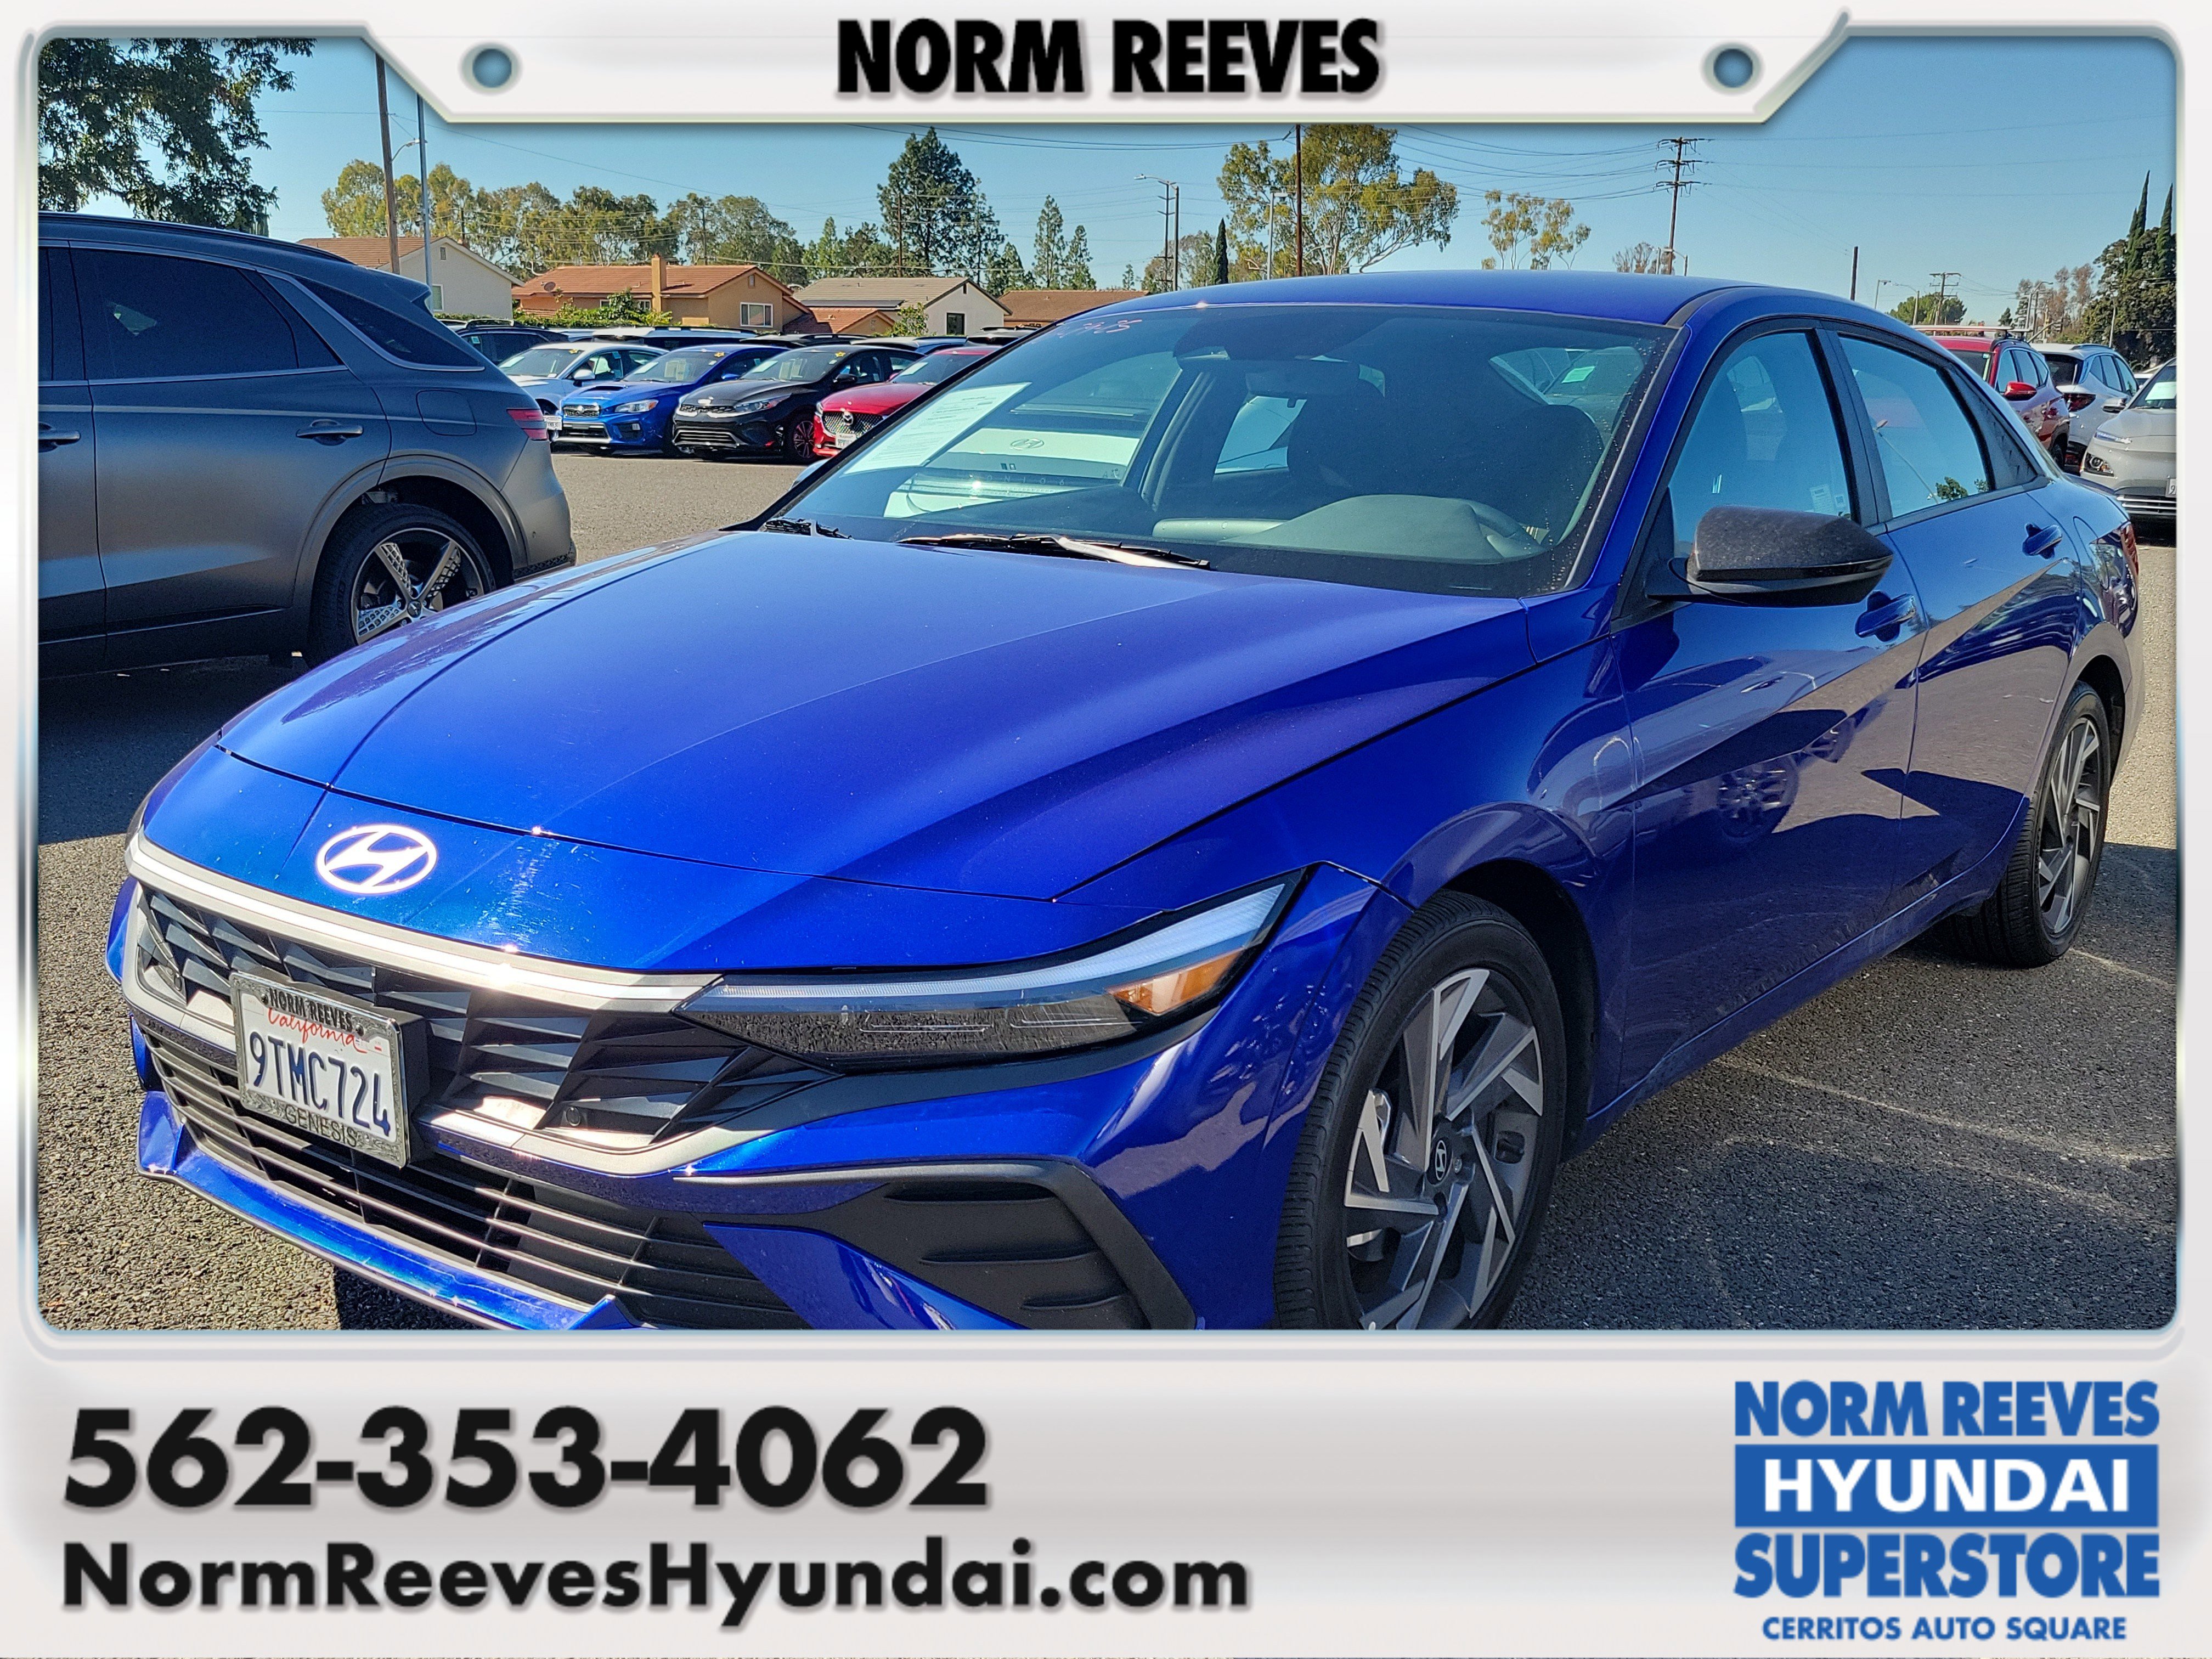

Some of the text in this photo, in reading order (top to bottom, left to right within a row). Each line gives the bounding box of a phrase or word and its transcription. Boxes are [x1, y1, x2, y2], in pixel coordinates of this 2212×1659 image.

[268, 1007, 367, 1053] California
[269, 987, 353, 1032] NORM REEVES
[250, 1031, 391, 1137] 9TMC724
[284, 1104, 357, 1148] GENESIS
